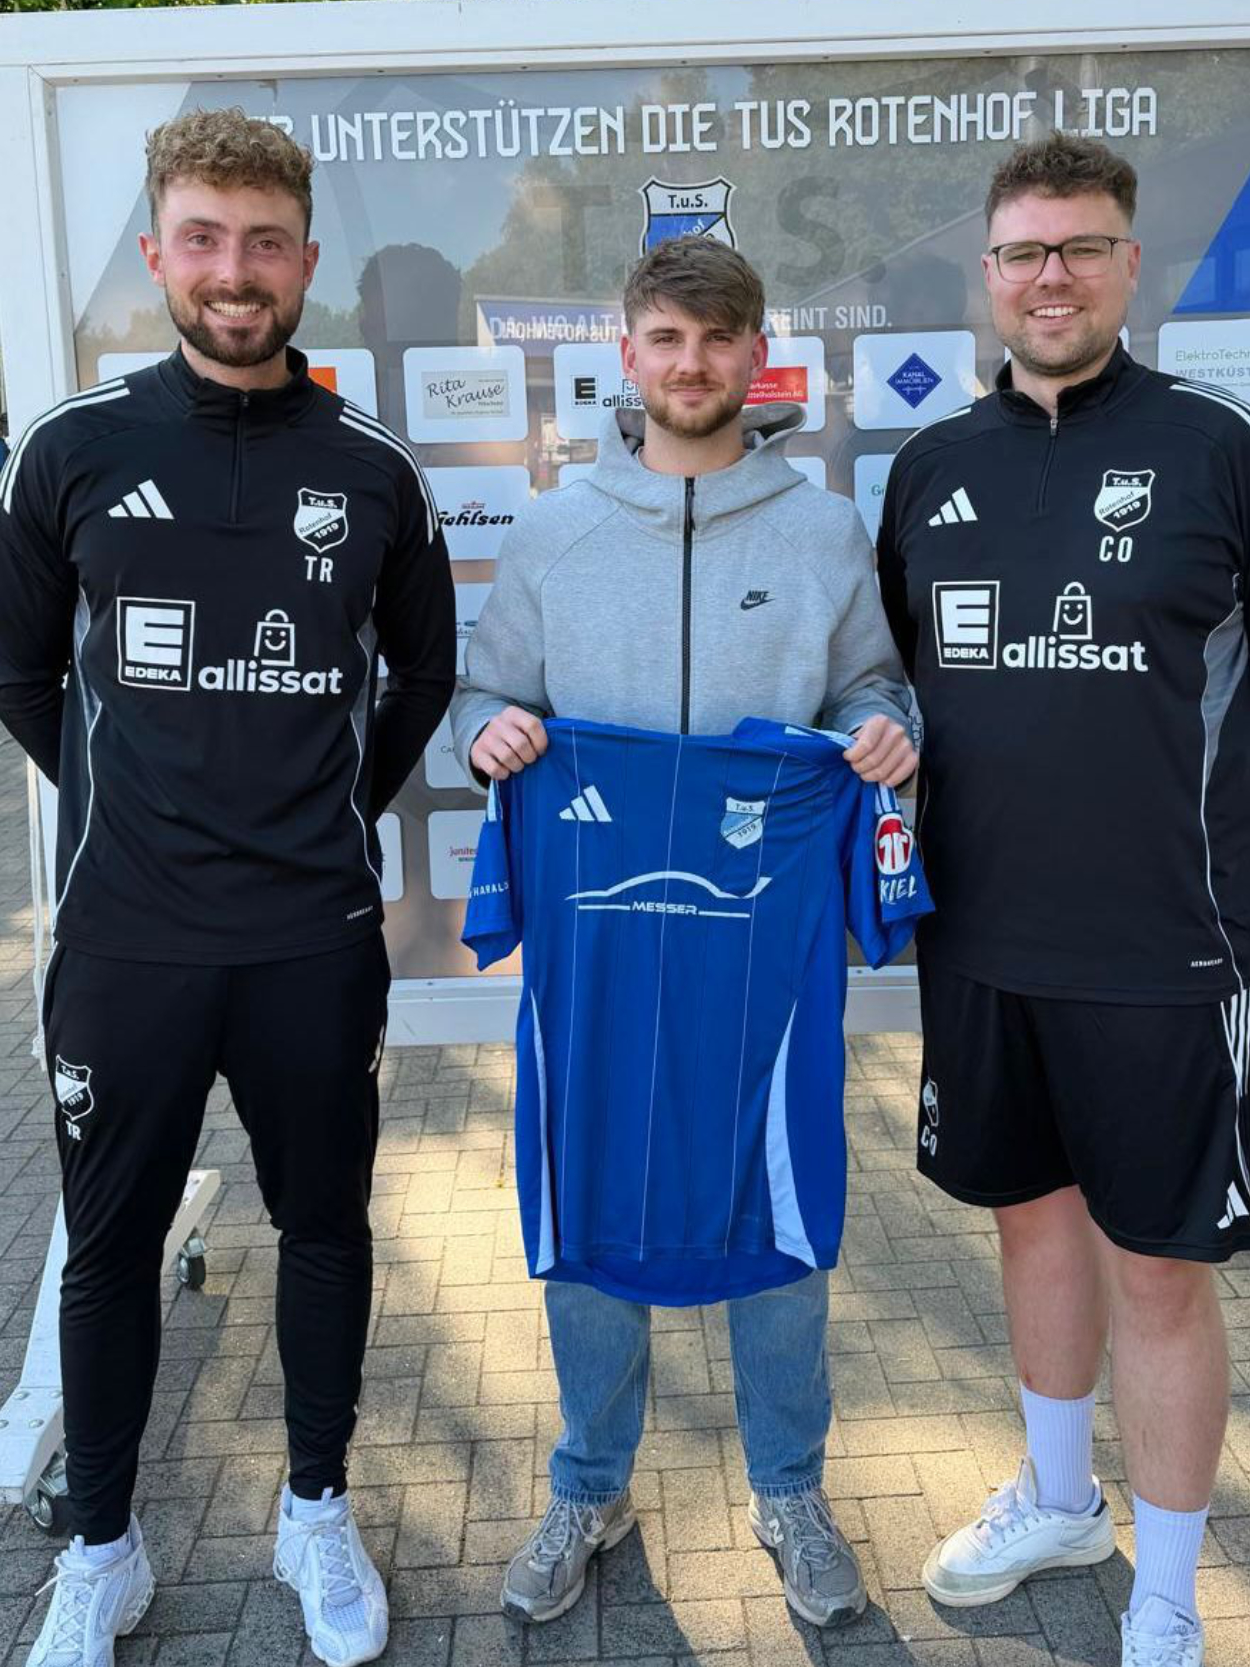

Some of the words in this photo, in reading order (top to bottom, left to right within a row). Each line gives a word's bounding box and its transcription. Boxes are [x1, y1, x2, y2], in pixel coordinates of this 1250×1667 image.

[311, 99, 626, 162] UNTERSTÜTZEN
[641, 101, 718, 154] DIE
[734, 99, 812, 150] TUS
[828, 91, 1038, 147] ROTENHOF
[1054, 86, 1158, 138] LIGA
[667, 193, 709, 209] T.u.S.
[834, 304, 893, 329] SIND.
[426, 379, 466, 399] Rita
[445, 384, 505, 409] Krause
[602, 394, 643, 407] alliss
[1113, 501, 1141, 519] 1919
[314, 522, 340, 539] 1919
[304, 555, 334, 583] TR
[746, 590, 770, 601] NIKE
[943, 647, 989, 660] EDEKA
[1002, 635, 1149, 672] allissat
[124, 665, 182, 682] EDEKA
[198, 658, 343, 694] allissat
[737, 823, 756, 838] 1919
[880, 875, 917, 904] KIEL
[632, 901, 698, 915] MESSER
[65, 1119, 82, 1141] TR
